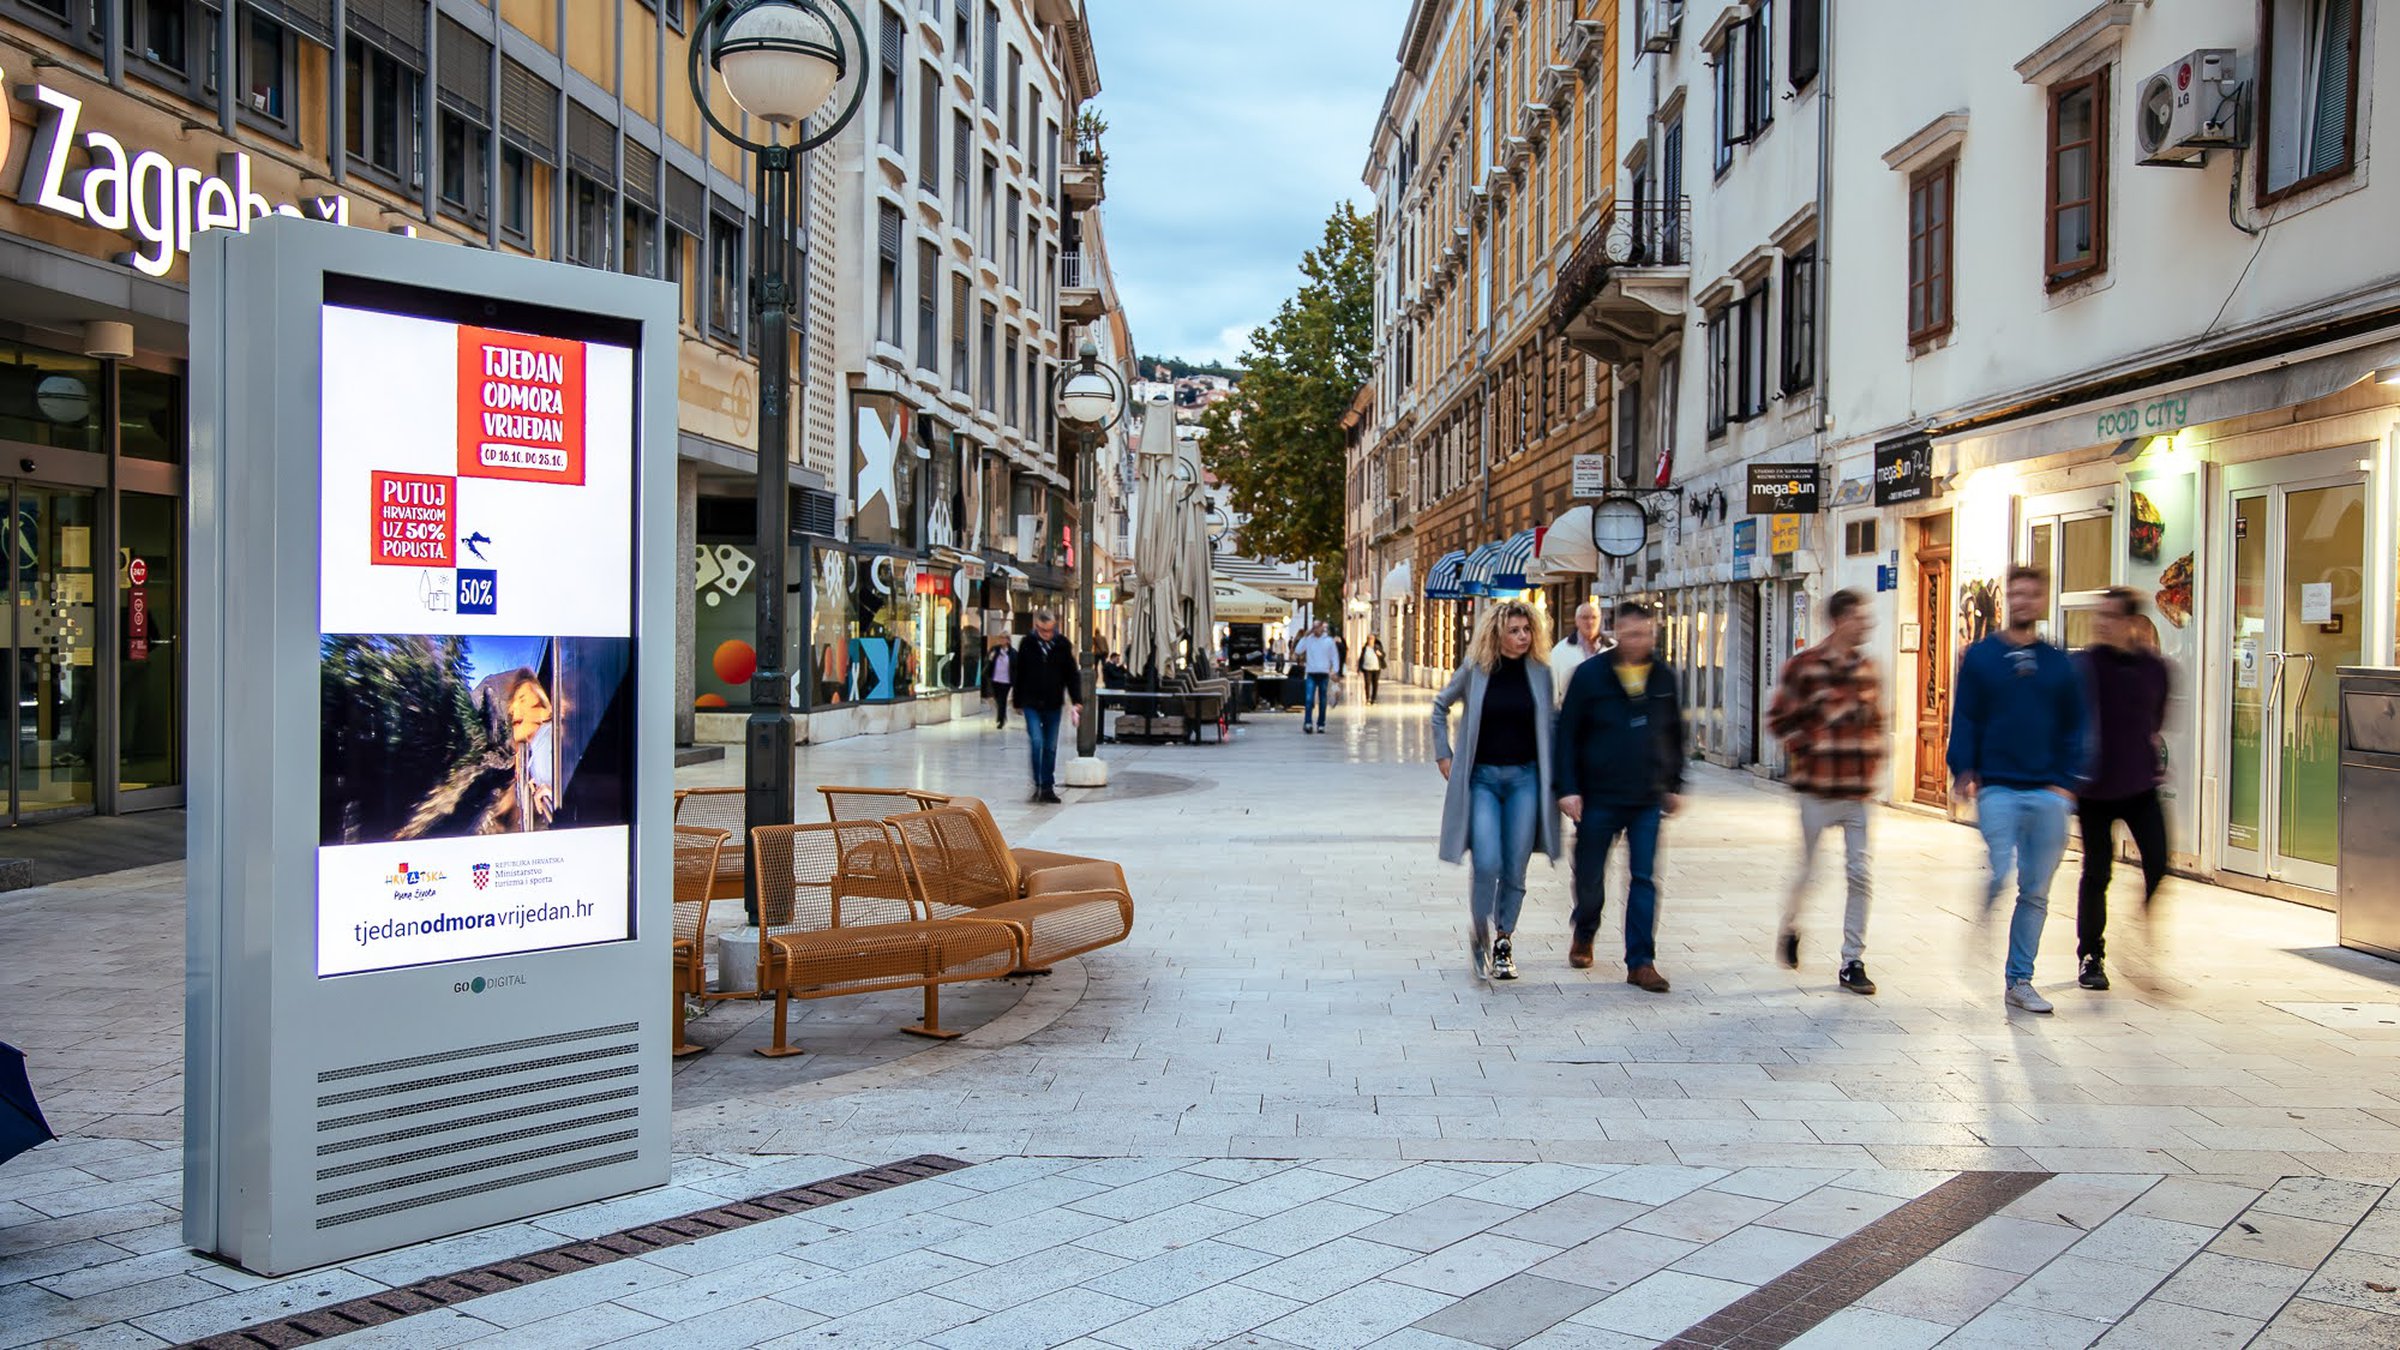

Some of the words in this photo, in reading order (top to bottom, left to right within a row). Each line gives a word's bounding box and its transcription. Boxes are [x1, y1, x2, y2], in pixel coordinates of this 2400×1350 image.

[2178, 93, 2190, 108] LG
[37, 84, 349, 277] Zagreb
[482, 345, 563, 385] TJEDAN
[482, 381, 563, 415] ODMORA
[482, 412, 563, 443] VRIJEDAN
[2097, 409, 2139, 438] FOOD
[2145, 396, 2189, 427] CITY
[1877, 458, 1911, 485] megaSun
[383, 480, 445, 506] PUTUJ
[1752, 480, 1815, 498] megaSun
[383, 506, 446, 522] HRVATSKOM
[383, 521, 403, 538] UZ
[405, 522, 446, 541] 50%
[461, 578, 493, 605] 50%
[495, 859, 531, 868] REPUBLIKA
[531, 857, 564, 866] HRVATSKA
[495, 868, 542, 878] Ministarstvo
[385, 870, 447, 885] HRVATSKA
[495, 878, 524, 888] turizma
[530, 876, 552, 886] sporta
[354, 899, 595, 946] tjedanodmoravrijedan.hr
[454, 982, 470, 993] GO
[486, 974, 527, 990] DIGITAL
